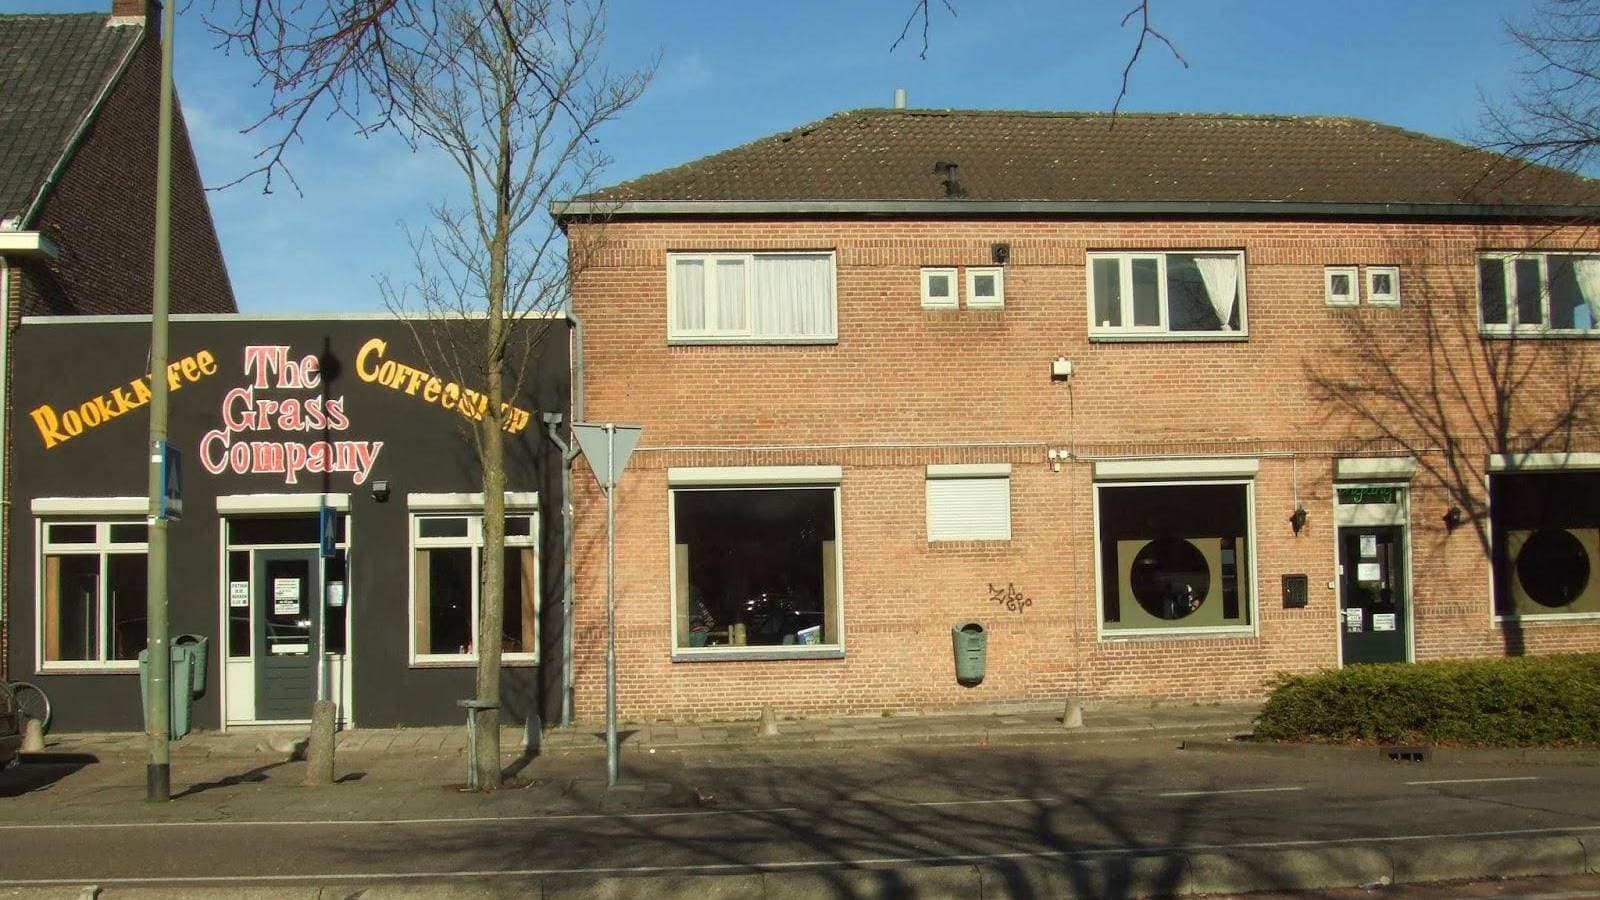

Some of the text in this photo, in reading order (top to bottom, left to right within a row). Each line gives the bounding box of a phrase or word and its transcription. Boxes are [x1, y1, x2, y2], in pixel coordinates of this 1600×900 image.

[244, 345, 322, 389] The
[222, 384, 350, 433] Grass
[199, 427, 384, 486] Company
